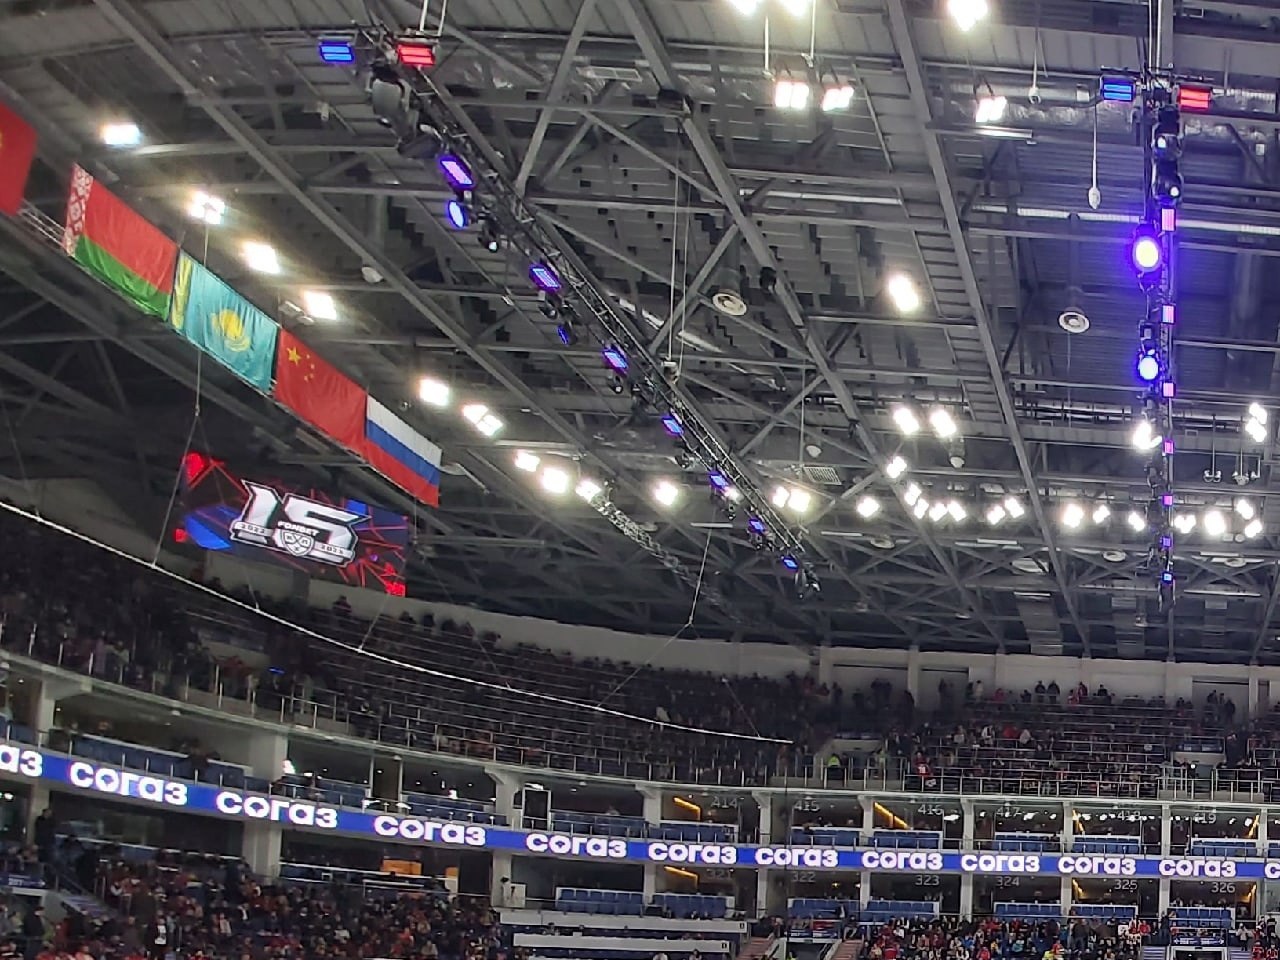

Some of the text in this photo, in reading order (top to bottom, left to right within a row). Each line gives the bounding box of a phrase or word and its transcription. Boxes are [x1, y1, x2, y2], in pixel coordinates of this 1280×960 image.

[794, 799, 820, 811] 415
[917, 802, 943, 815] 416
[70, 761, 188, 806] согаз
[216, 791, 338, 828] согаз
[374, 815, 486, 846] согаз
[526, 833, 627, 858] согаз
[648, 842, 737, 865] согаз
[755, 847, 838, 868] согаз
[862, 851, 943, 870] согаз
[961, 854, 1040, 873] согаз
[1058, 856, 1136, 876] согаз
[1158, 859, 1236, 877] согаз
[791, 873, 816, 883] 322
[914, 875, 940, 886] 323
[1211, 882, 1236, 894] 326
